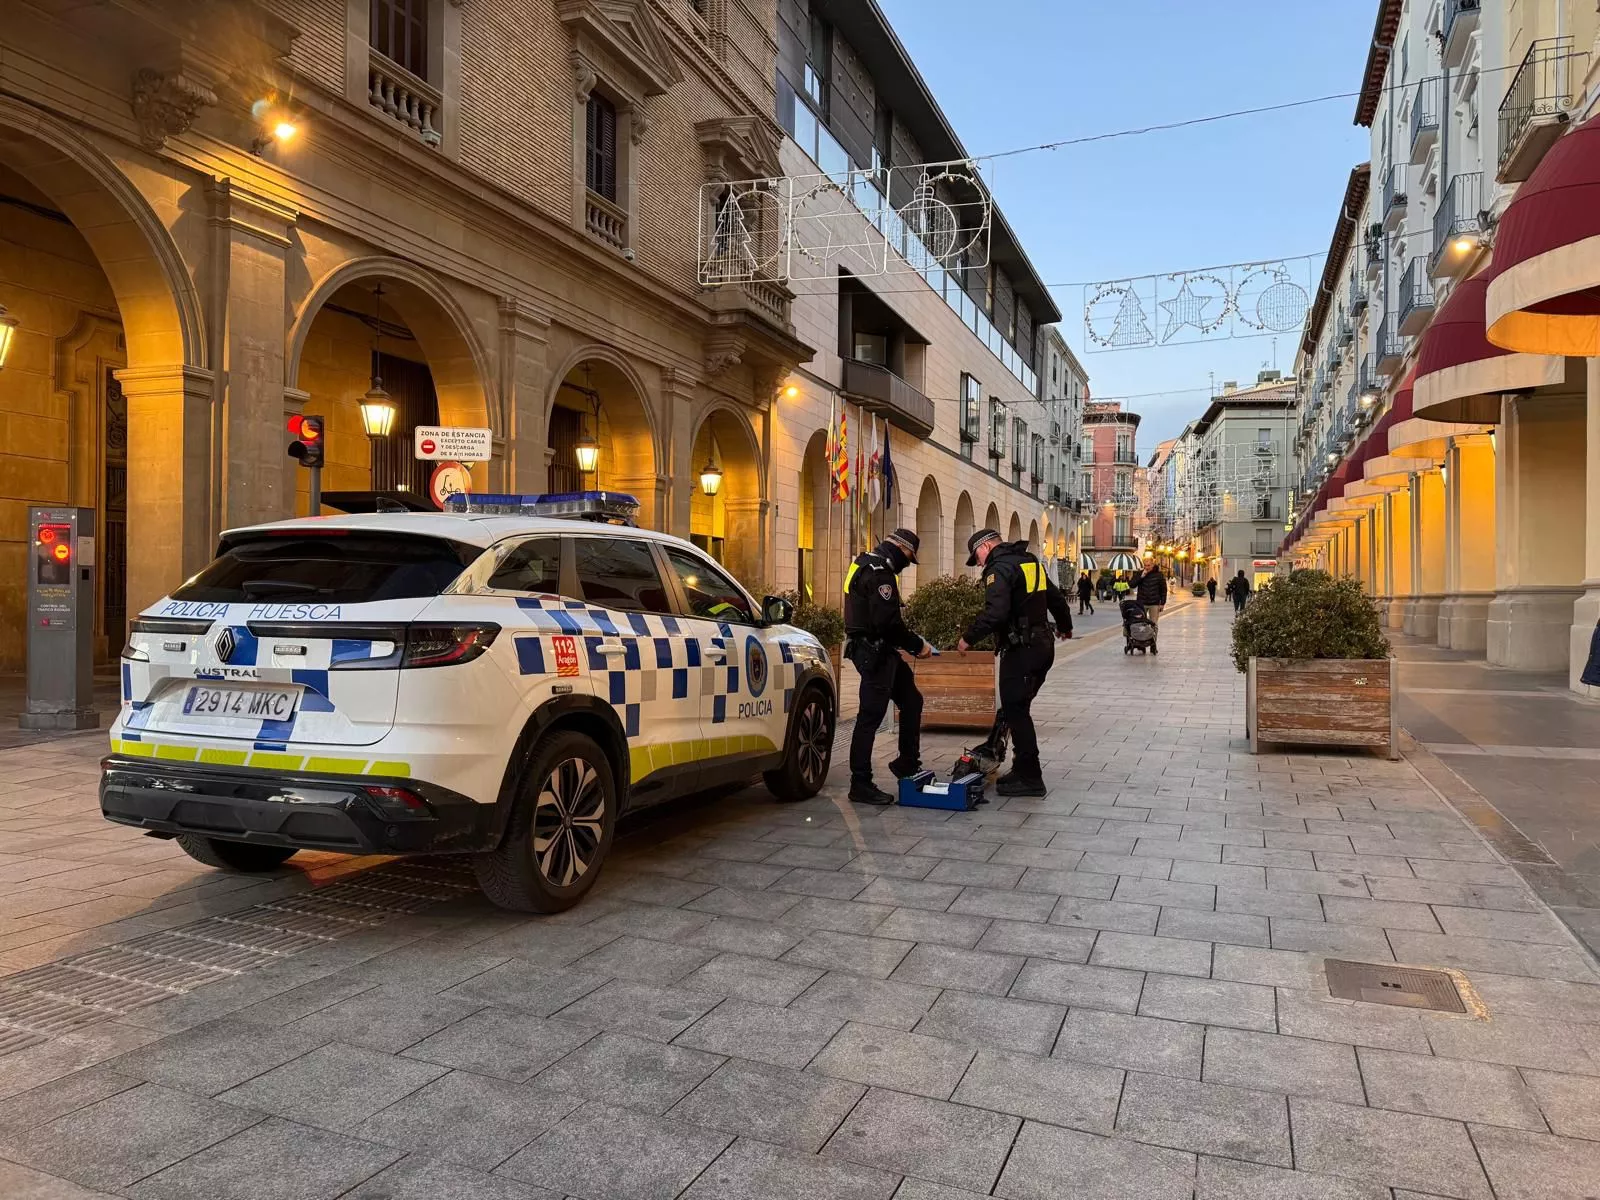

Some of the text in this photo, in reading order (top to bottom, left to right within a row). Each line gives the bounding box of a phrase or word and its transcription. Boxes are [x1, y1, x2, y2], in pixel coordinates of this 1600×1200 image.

[160, 602, 341, 620] POLICIA HUESCA
[555, 639, 575, 654] 112
[558, 655, 577, 666] Aragón
[193, 666, 261, 678] AUSTRAL
[194, 690, 289, 716] 2914 MKC
[738, 699, 773, 719] POLICIA
